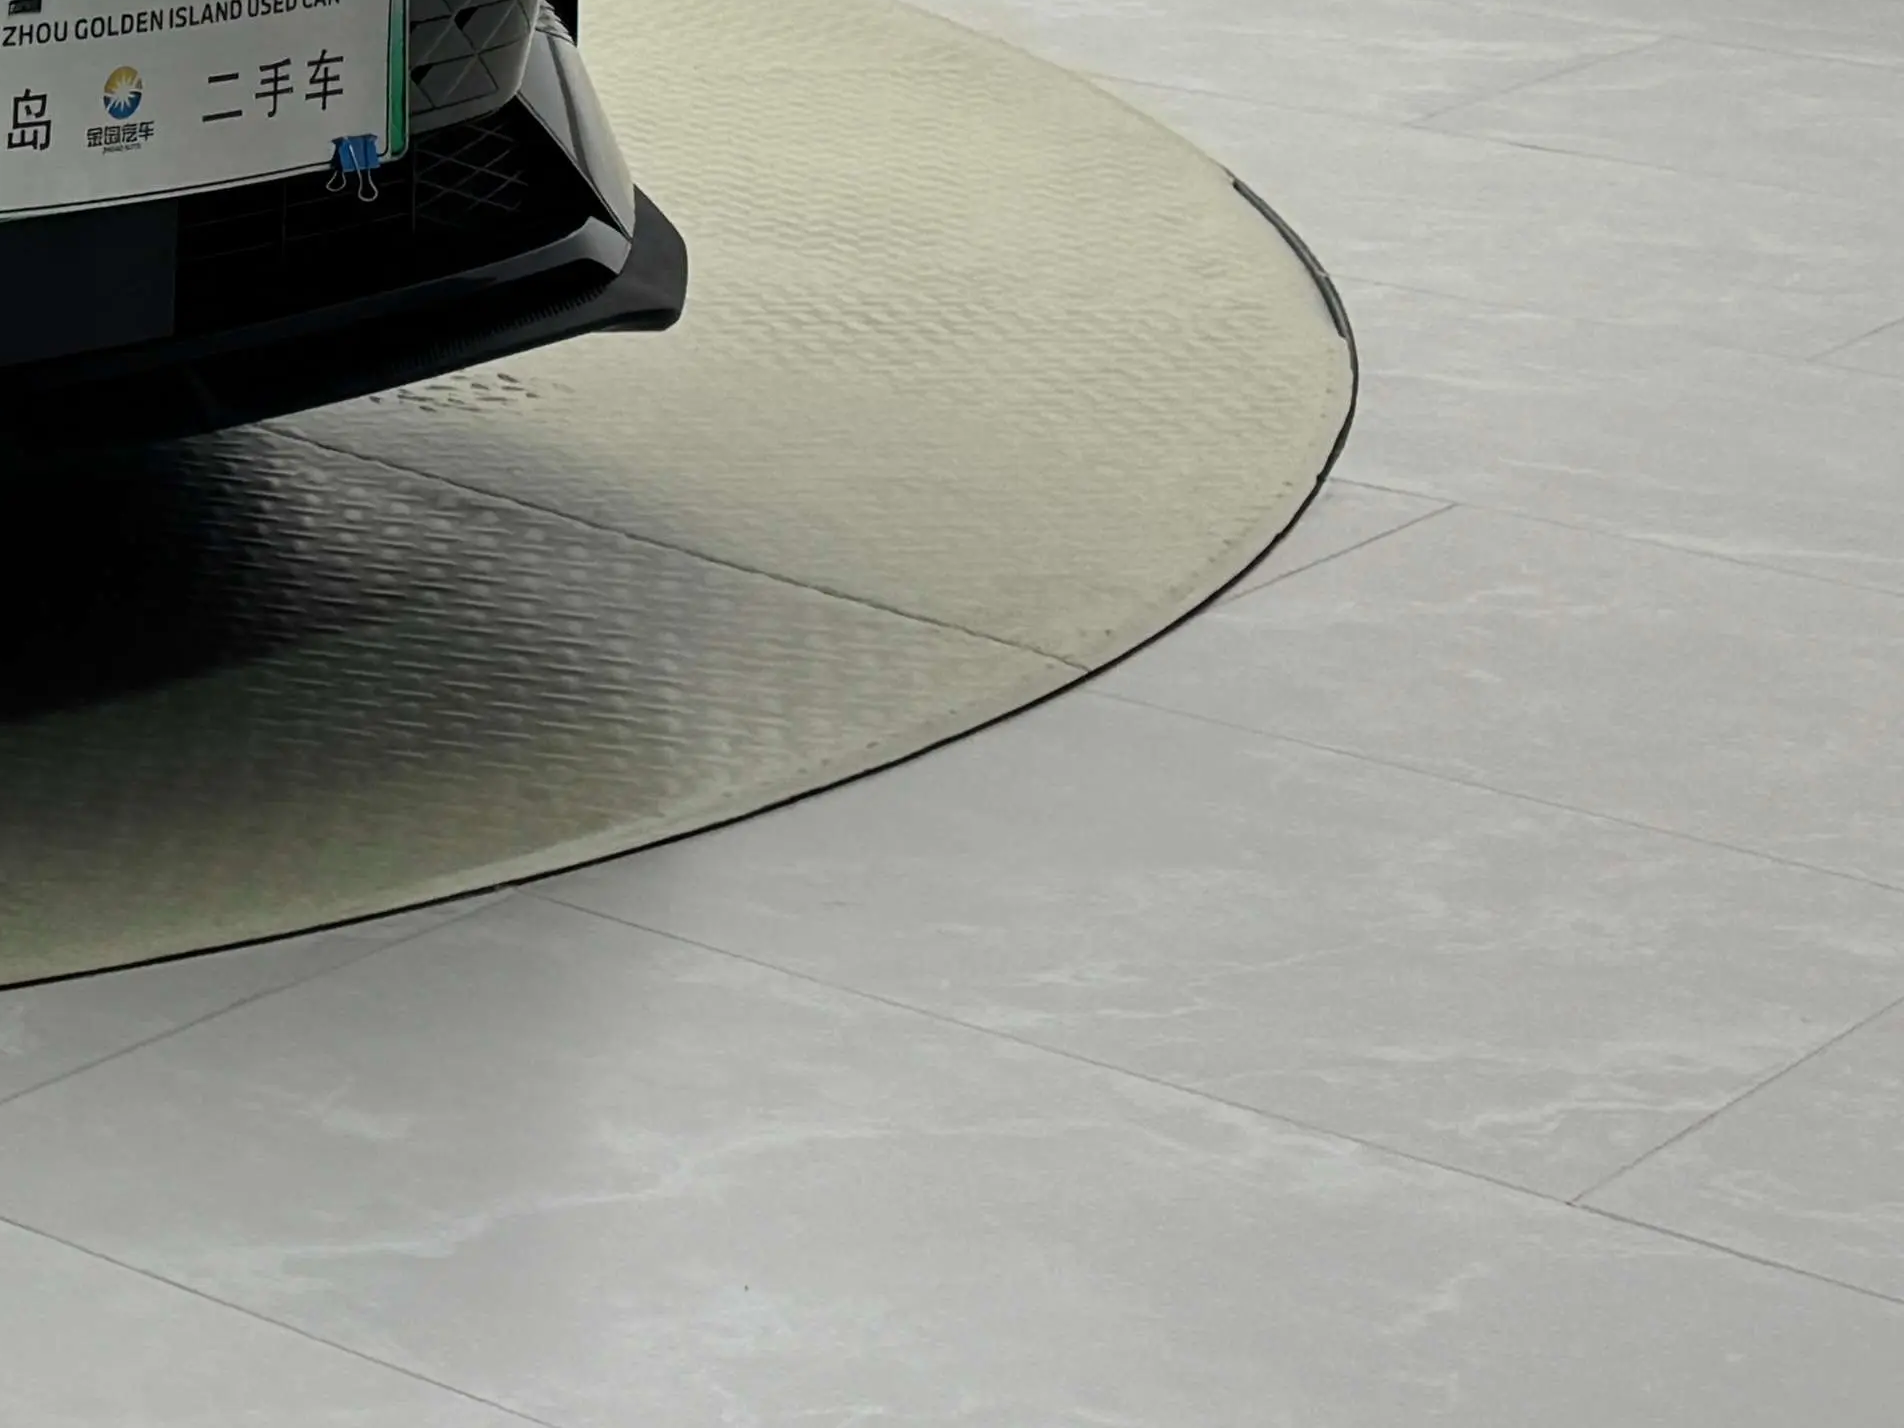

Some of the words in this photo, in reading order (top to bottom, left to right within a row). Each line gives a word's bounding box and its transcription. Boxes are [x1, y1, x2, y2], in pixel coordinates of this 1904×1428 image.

[75, 9, 163, 40] GOLDEN
[169, 0, 242, 29] ISLAND
[202, 49, 343, 122] 二手车
